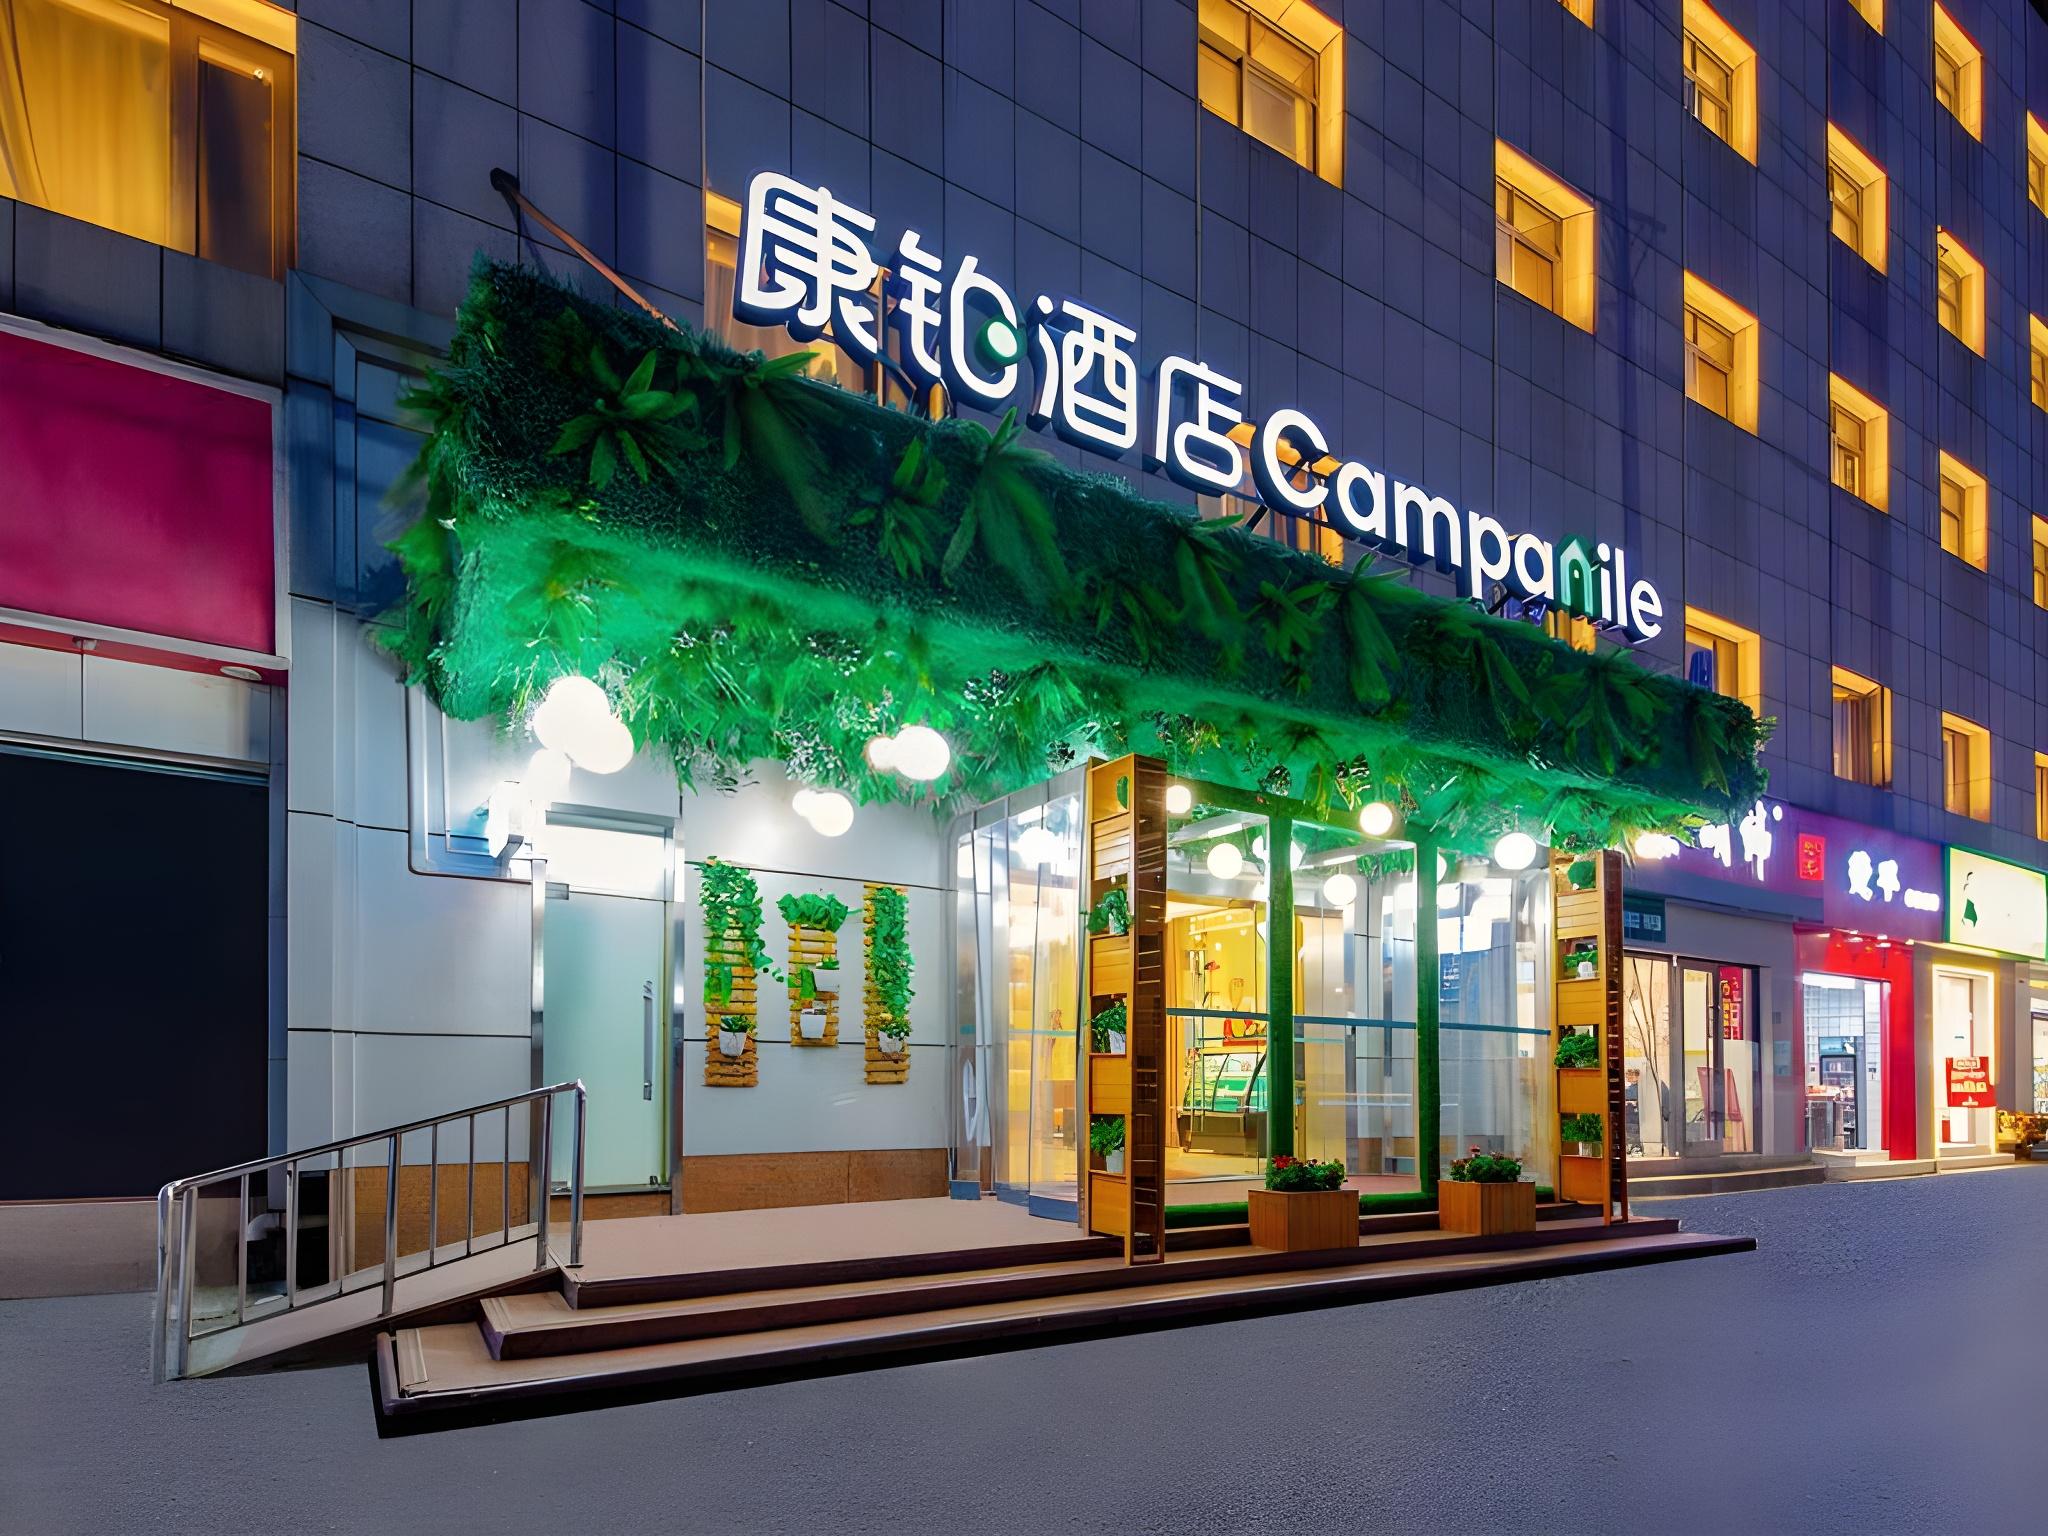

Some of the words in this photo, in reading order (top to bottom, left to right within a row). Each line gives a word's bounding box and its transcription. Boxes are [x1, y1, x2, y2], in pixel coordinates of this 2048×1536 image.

[740, 171, 1243, 488] 康铂酒店
[1261, 408, 1664, 640] Campanile
